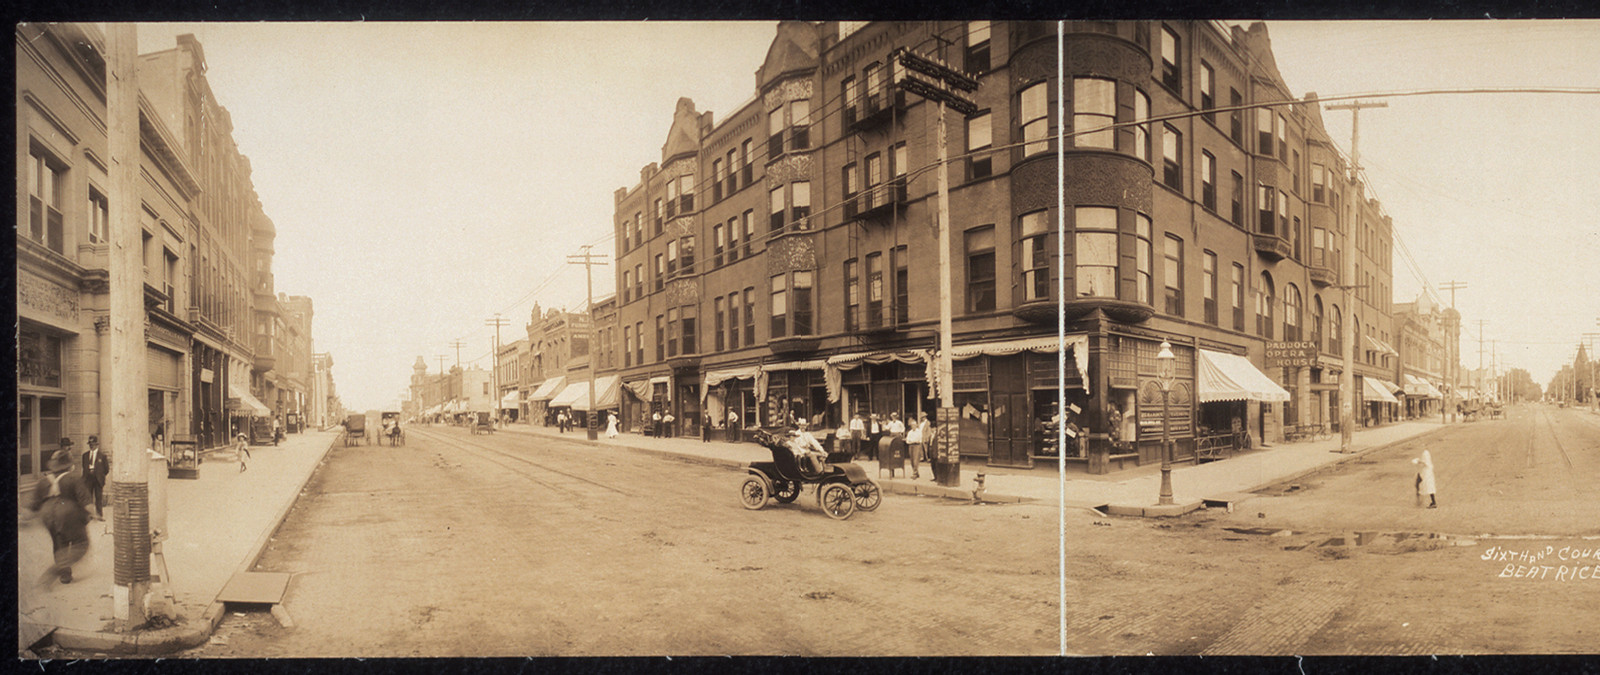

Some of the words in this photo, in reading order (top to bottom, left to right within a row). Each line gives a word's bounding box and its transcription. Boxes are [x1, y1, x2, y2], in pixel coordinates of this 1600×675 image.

[1266, 341, 1316, 349] PADDOCK
[1266, 350, 1306, 358] OPERA
[1276, 359, 1316, 367] HOUSE
